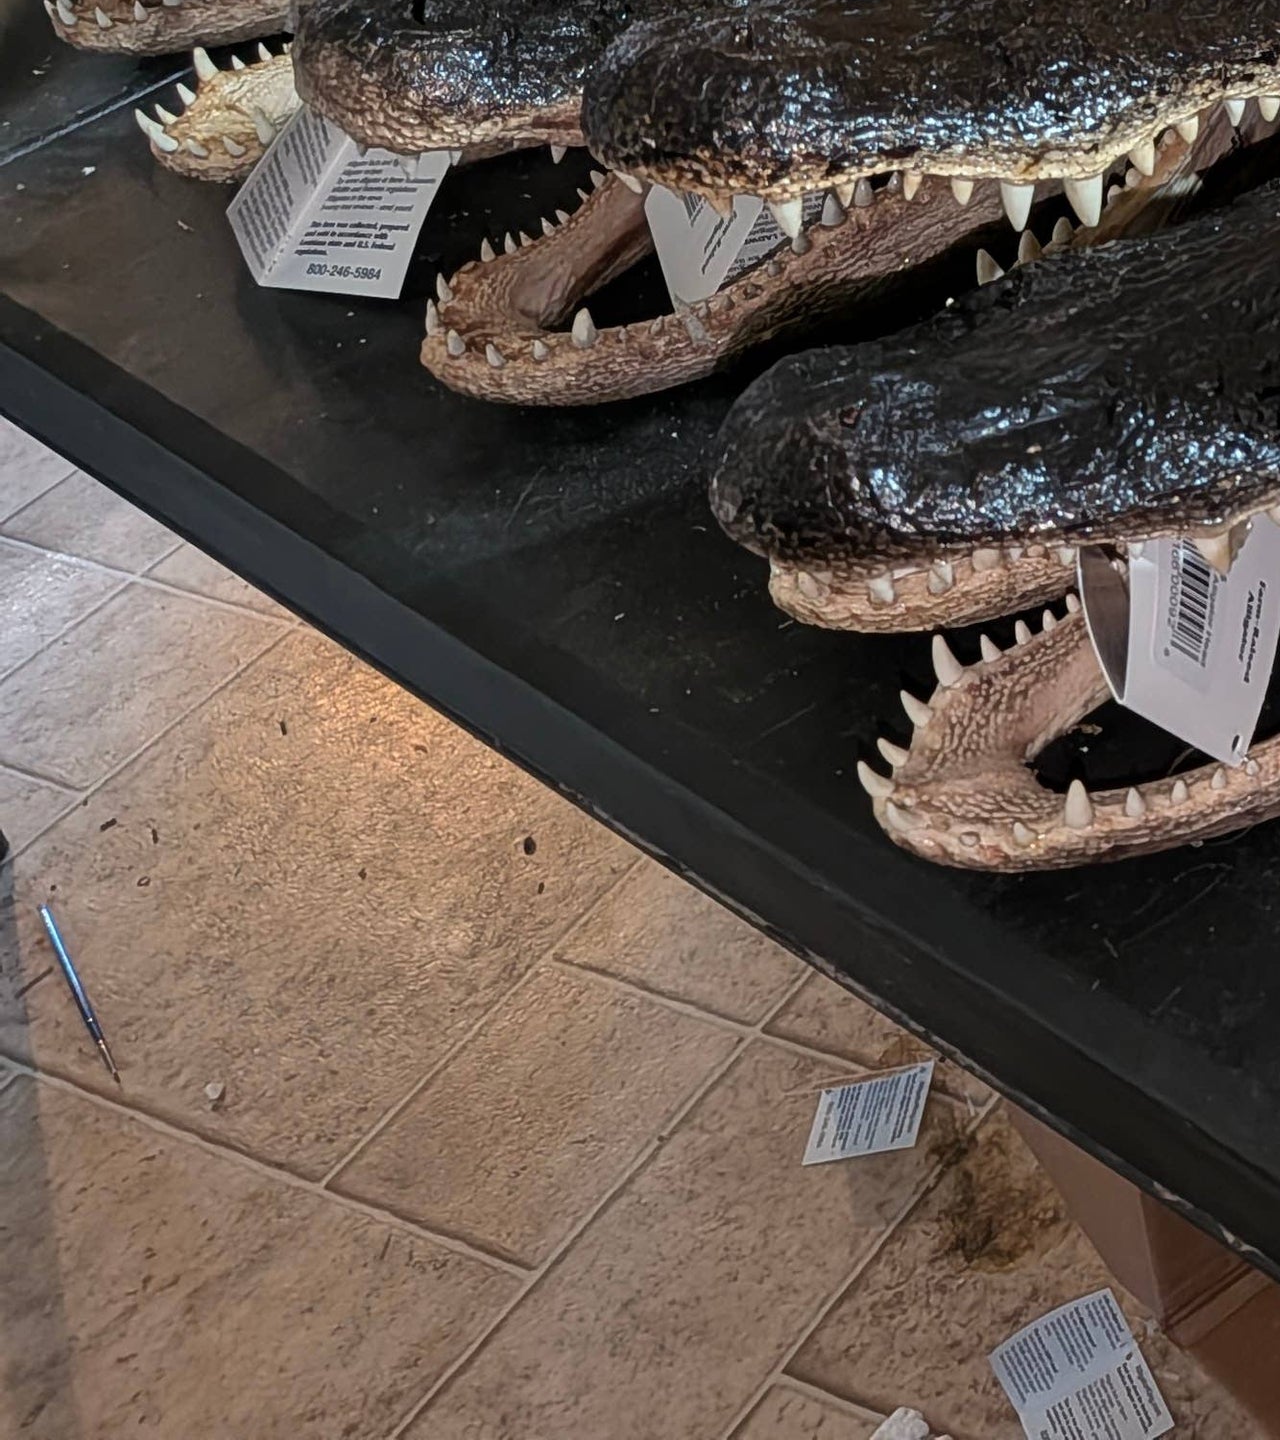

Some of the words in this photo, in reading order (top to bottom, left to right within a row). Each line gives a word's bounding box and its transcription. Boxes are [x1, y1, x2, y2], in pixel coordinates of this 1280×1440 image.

[306, 263, 382, 280] 800-246-5984
[1238, 591, 1255, 662] Alligator
[1243, 580, 1267, 683] Farm-Raised
